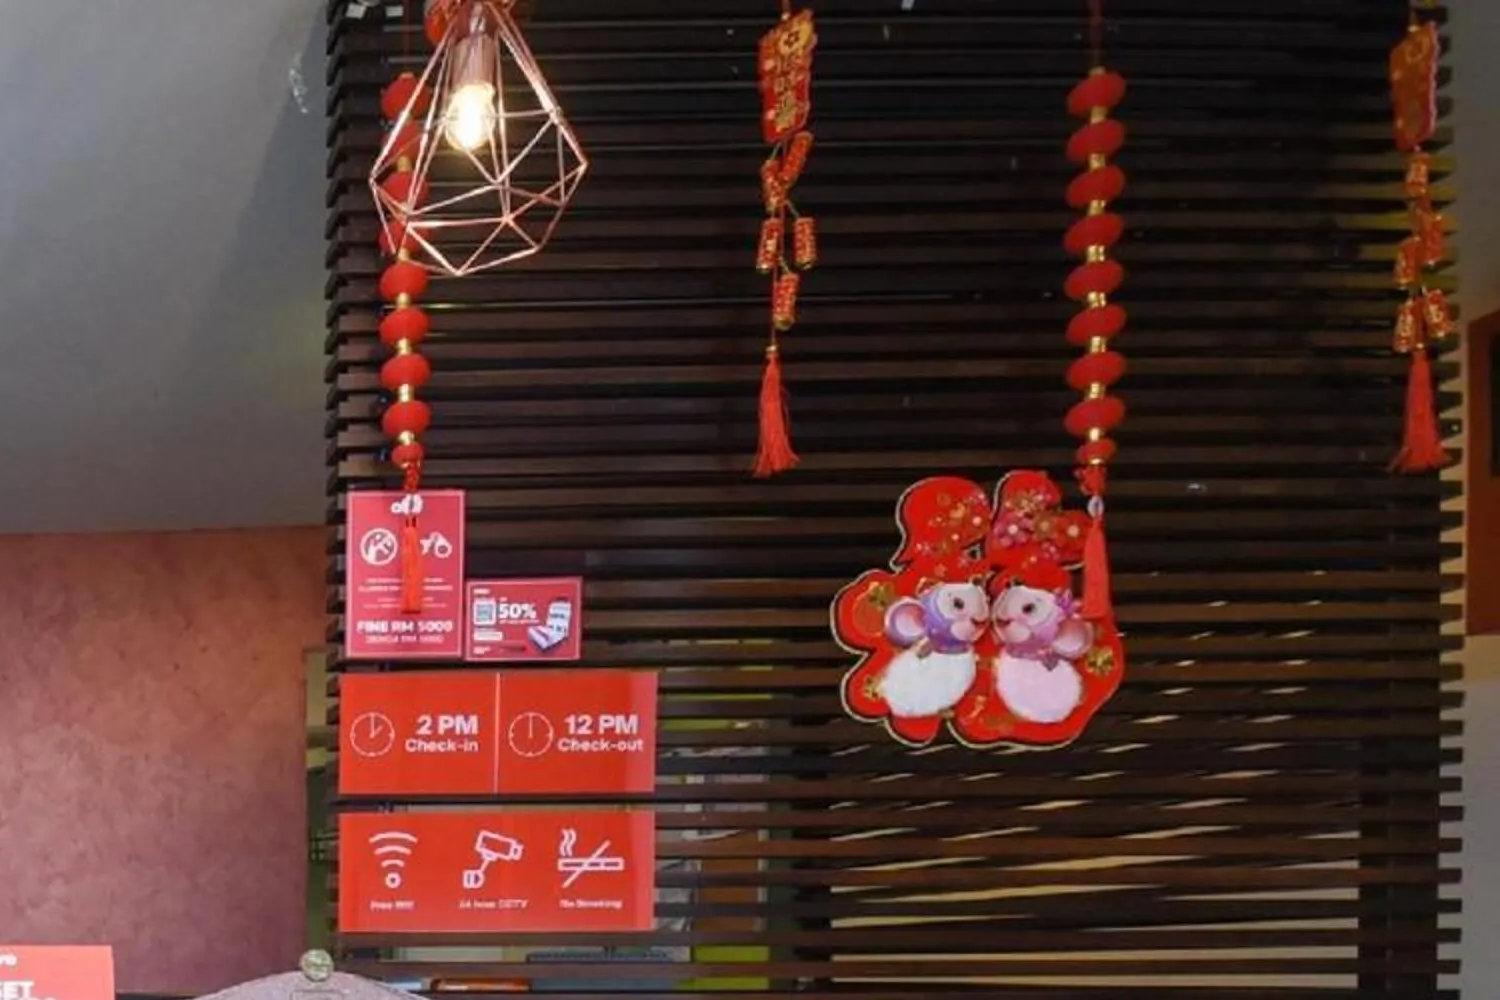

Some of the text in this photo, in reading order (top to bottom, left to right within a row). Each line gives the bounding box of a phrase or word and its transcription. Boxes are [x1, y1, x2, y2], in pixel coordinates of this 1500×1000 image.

[499, 602, 537, 620] 50%
[356, 620, 389, 634] FINE
[391, 621, 414, 633] RM
[415, 714, 479, 735] 2 PM
[564, 714, 638, 735] 12 PM
[404, 738, 479, 753] Check-in
[557, 737, 644, 753] Check-out
